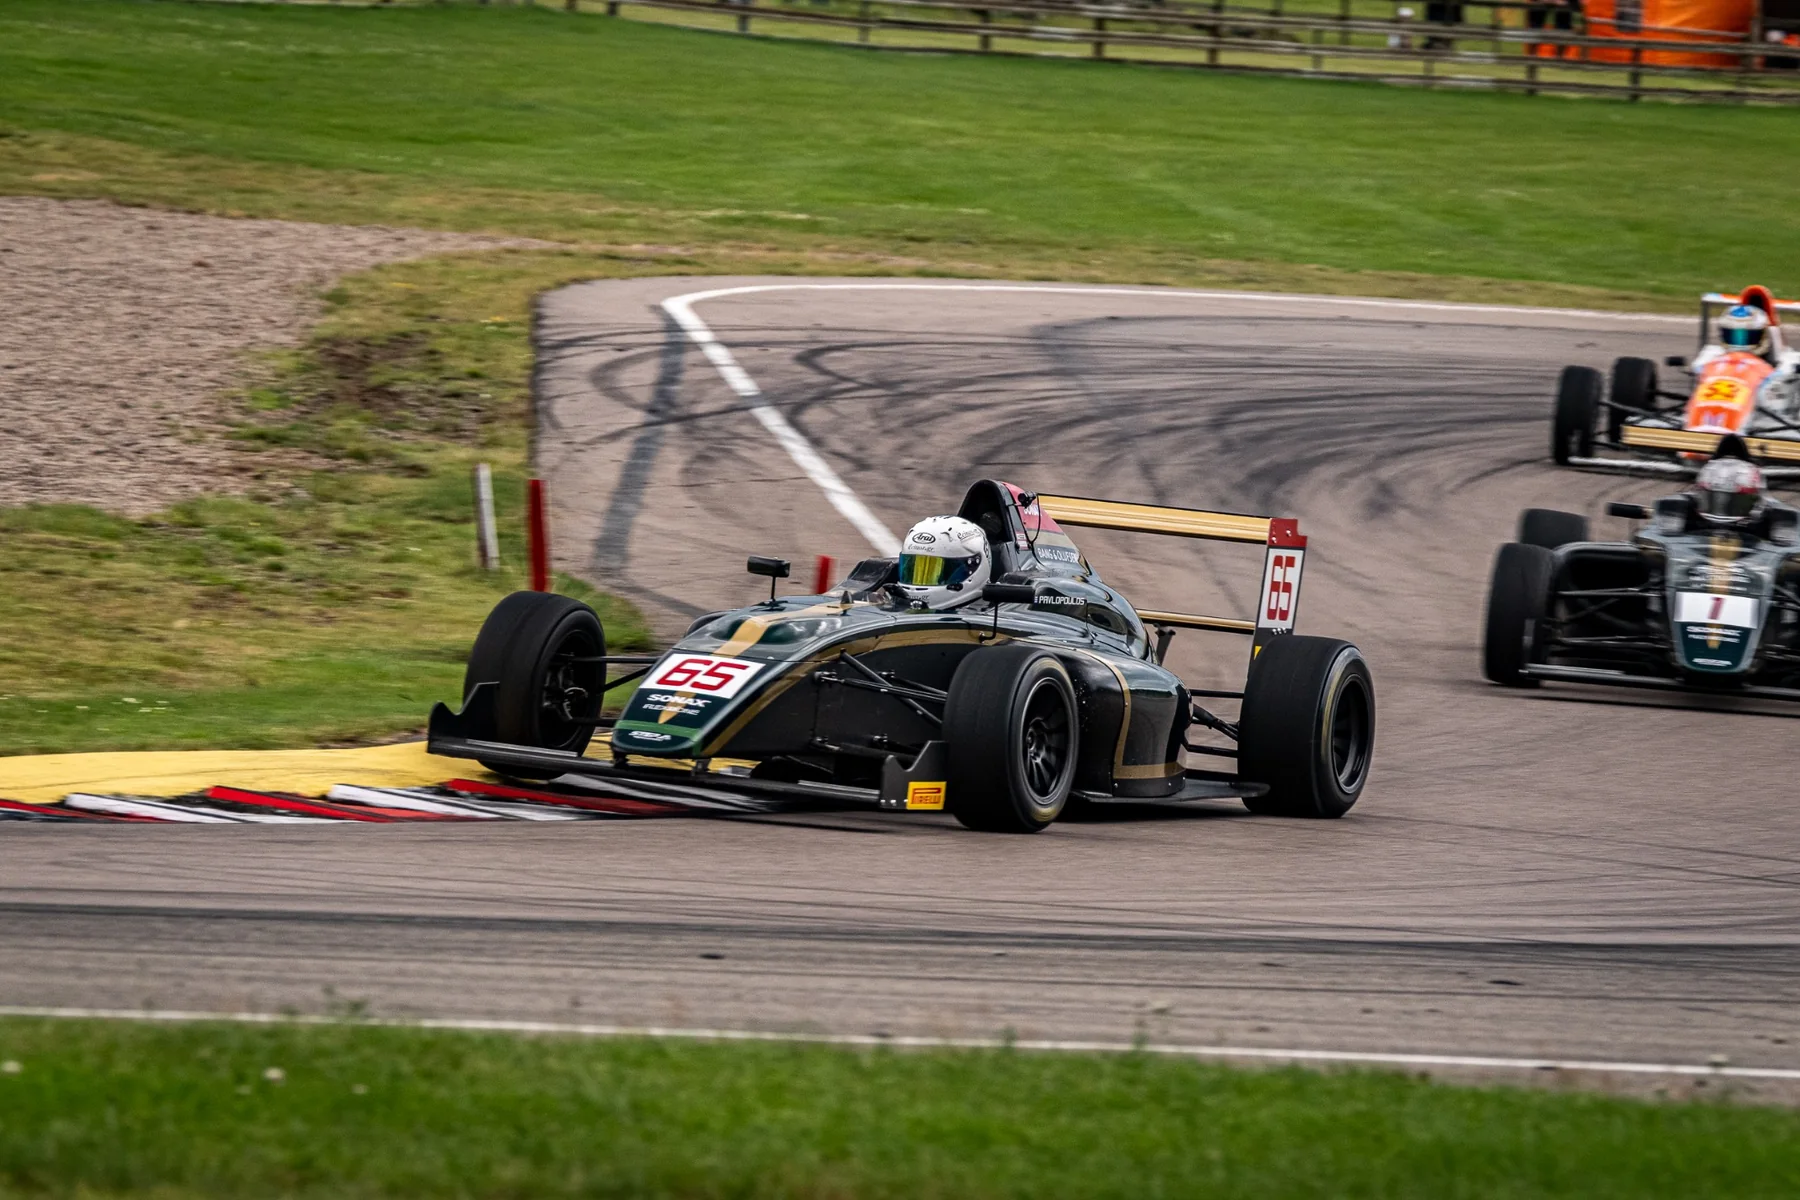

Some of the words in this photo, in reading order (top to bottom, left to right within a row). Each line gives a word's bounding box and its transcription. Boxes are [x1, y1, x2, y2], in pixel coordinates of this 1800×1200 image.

[914, 532, 933, 542] Arai
[1267, 555, 1296, 621] 65
[1039, 595, 1085, 605] PAVLOPOULOS
[656, 658, 750, 691] 65
[646, 693, 712, 708] SONAX
